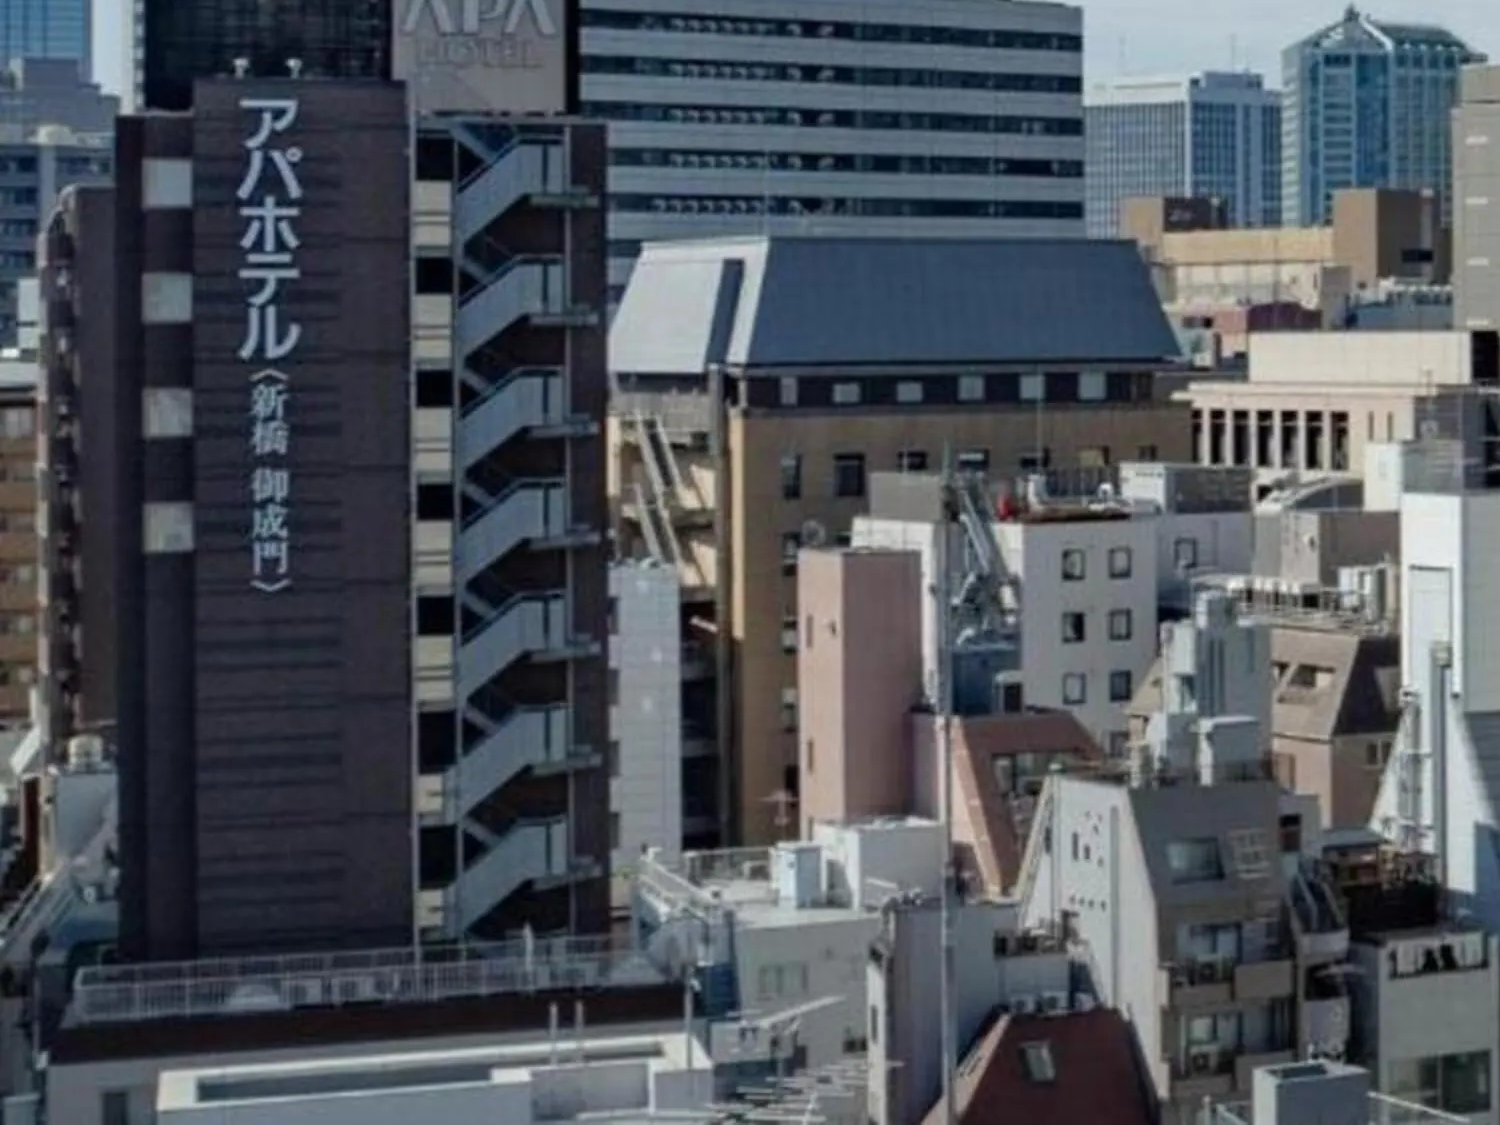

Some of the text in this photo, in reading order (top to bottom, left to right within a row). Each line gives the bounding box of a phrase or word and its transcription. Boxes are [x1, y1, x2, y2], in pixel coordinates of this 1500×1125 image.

[236, 98, 303, 360] アパホテル
